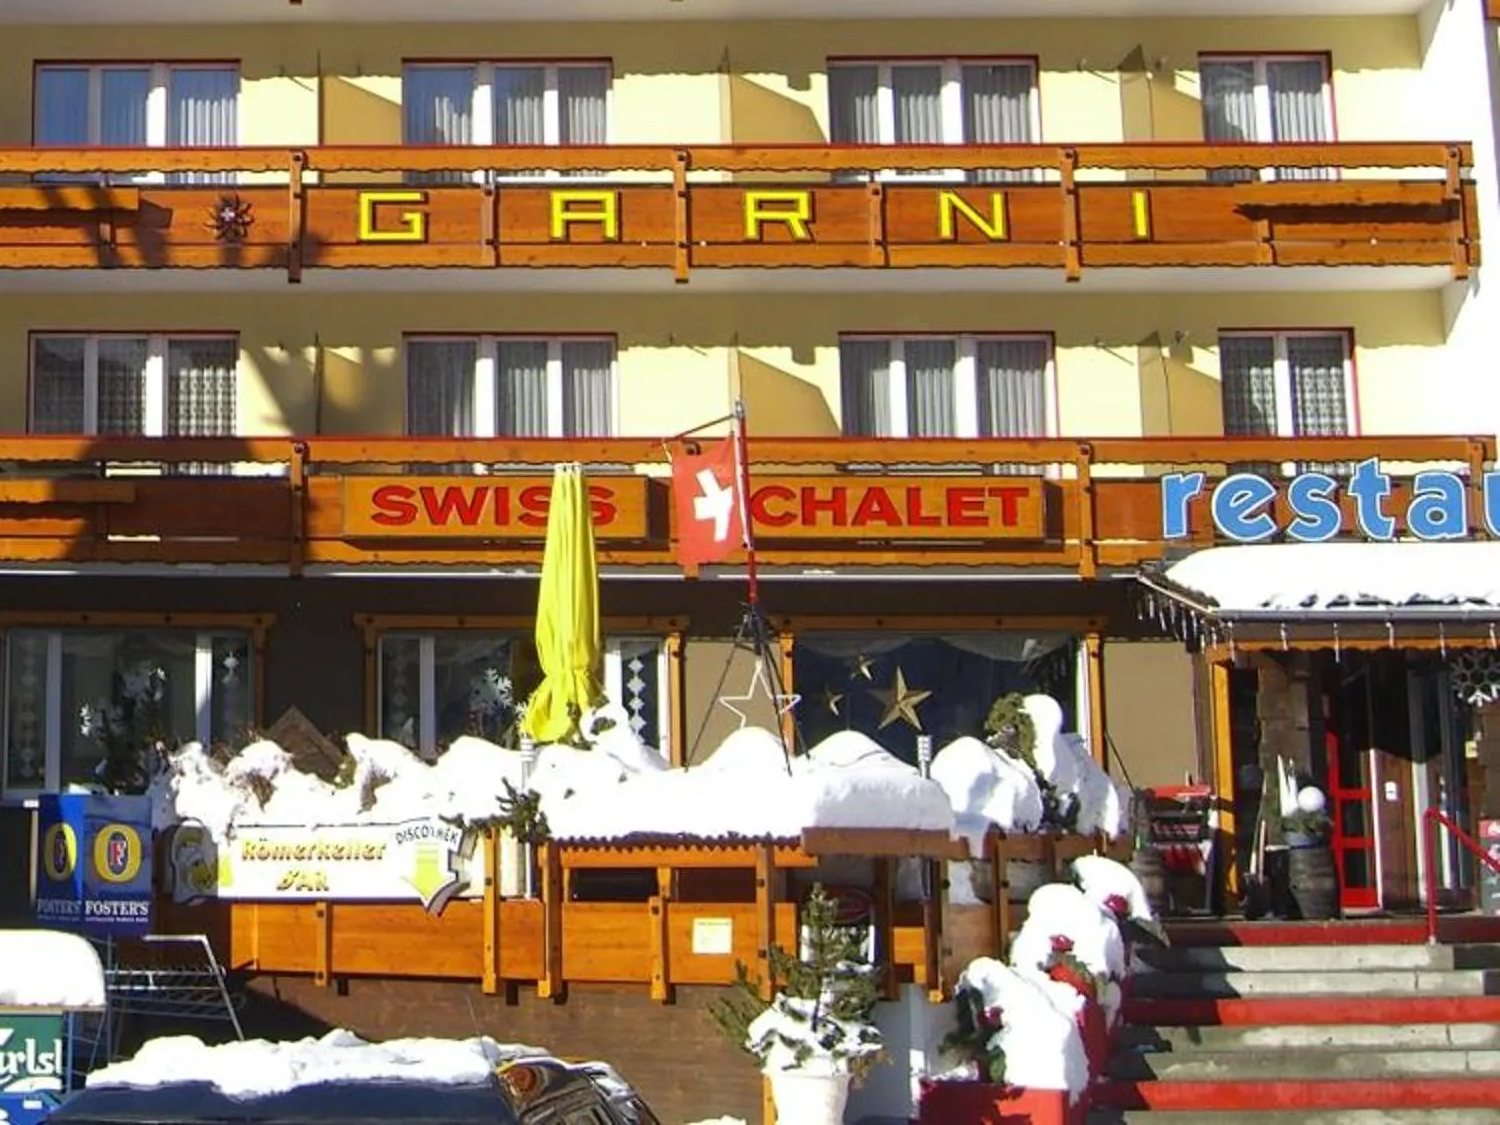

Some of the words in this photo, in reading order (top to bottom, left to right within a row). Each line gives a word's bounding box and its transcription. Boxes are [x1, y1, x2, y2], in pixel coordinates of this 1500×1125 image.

[357, 189, 1150, 242] GARNI
[371, 484, 618, 526] SWISS
[750, 484, 1030, 527] CHALET
[1161, 457, 1500, 542] resta
